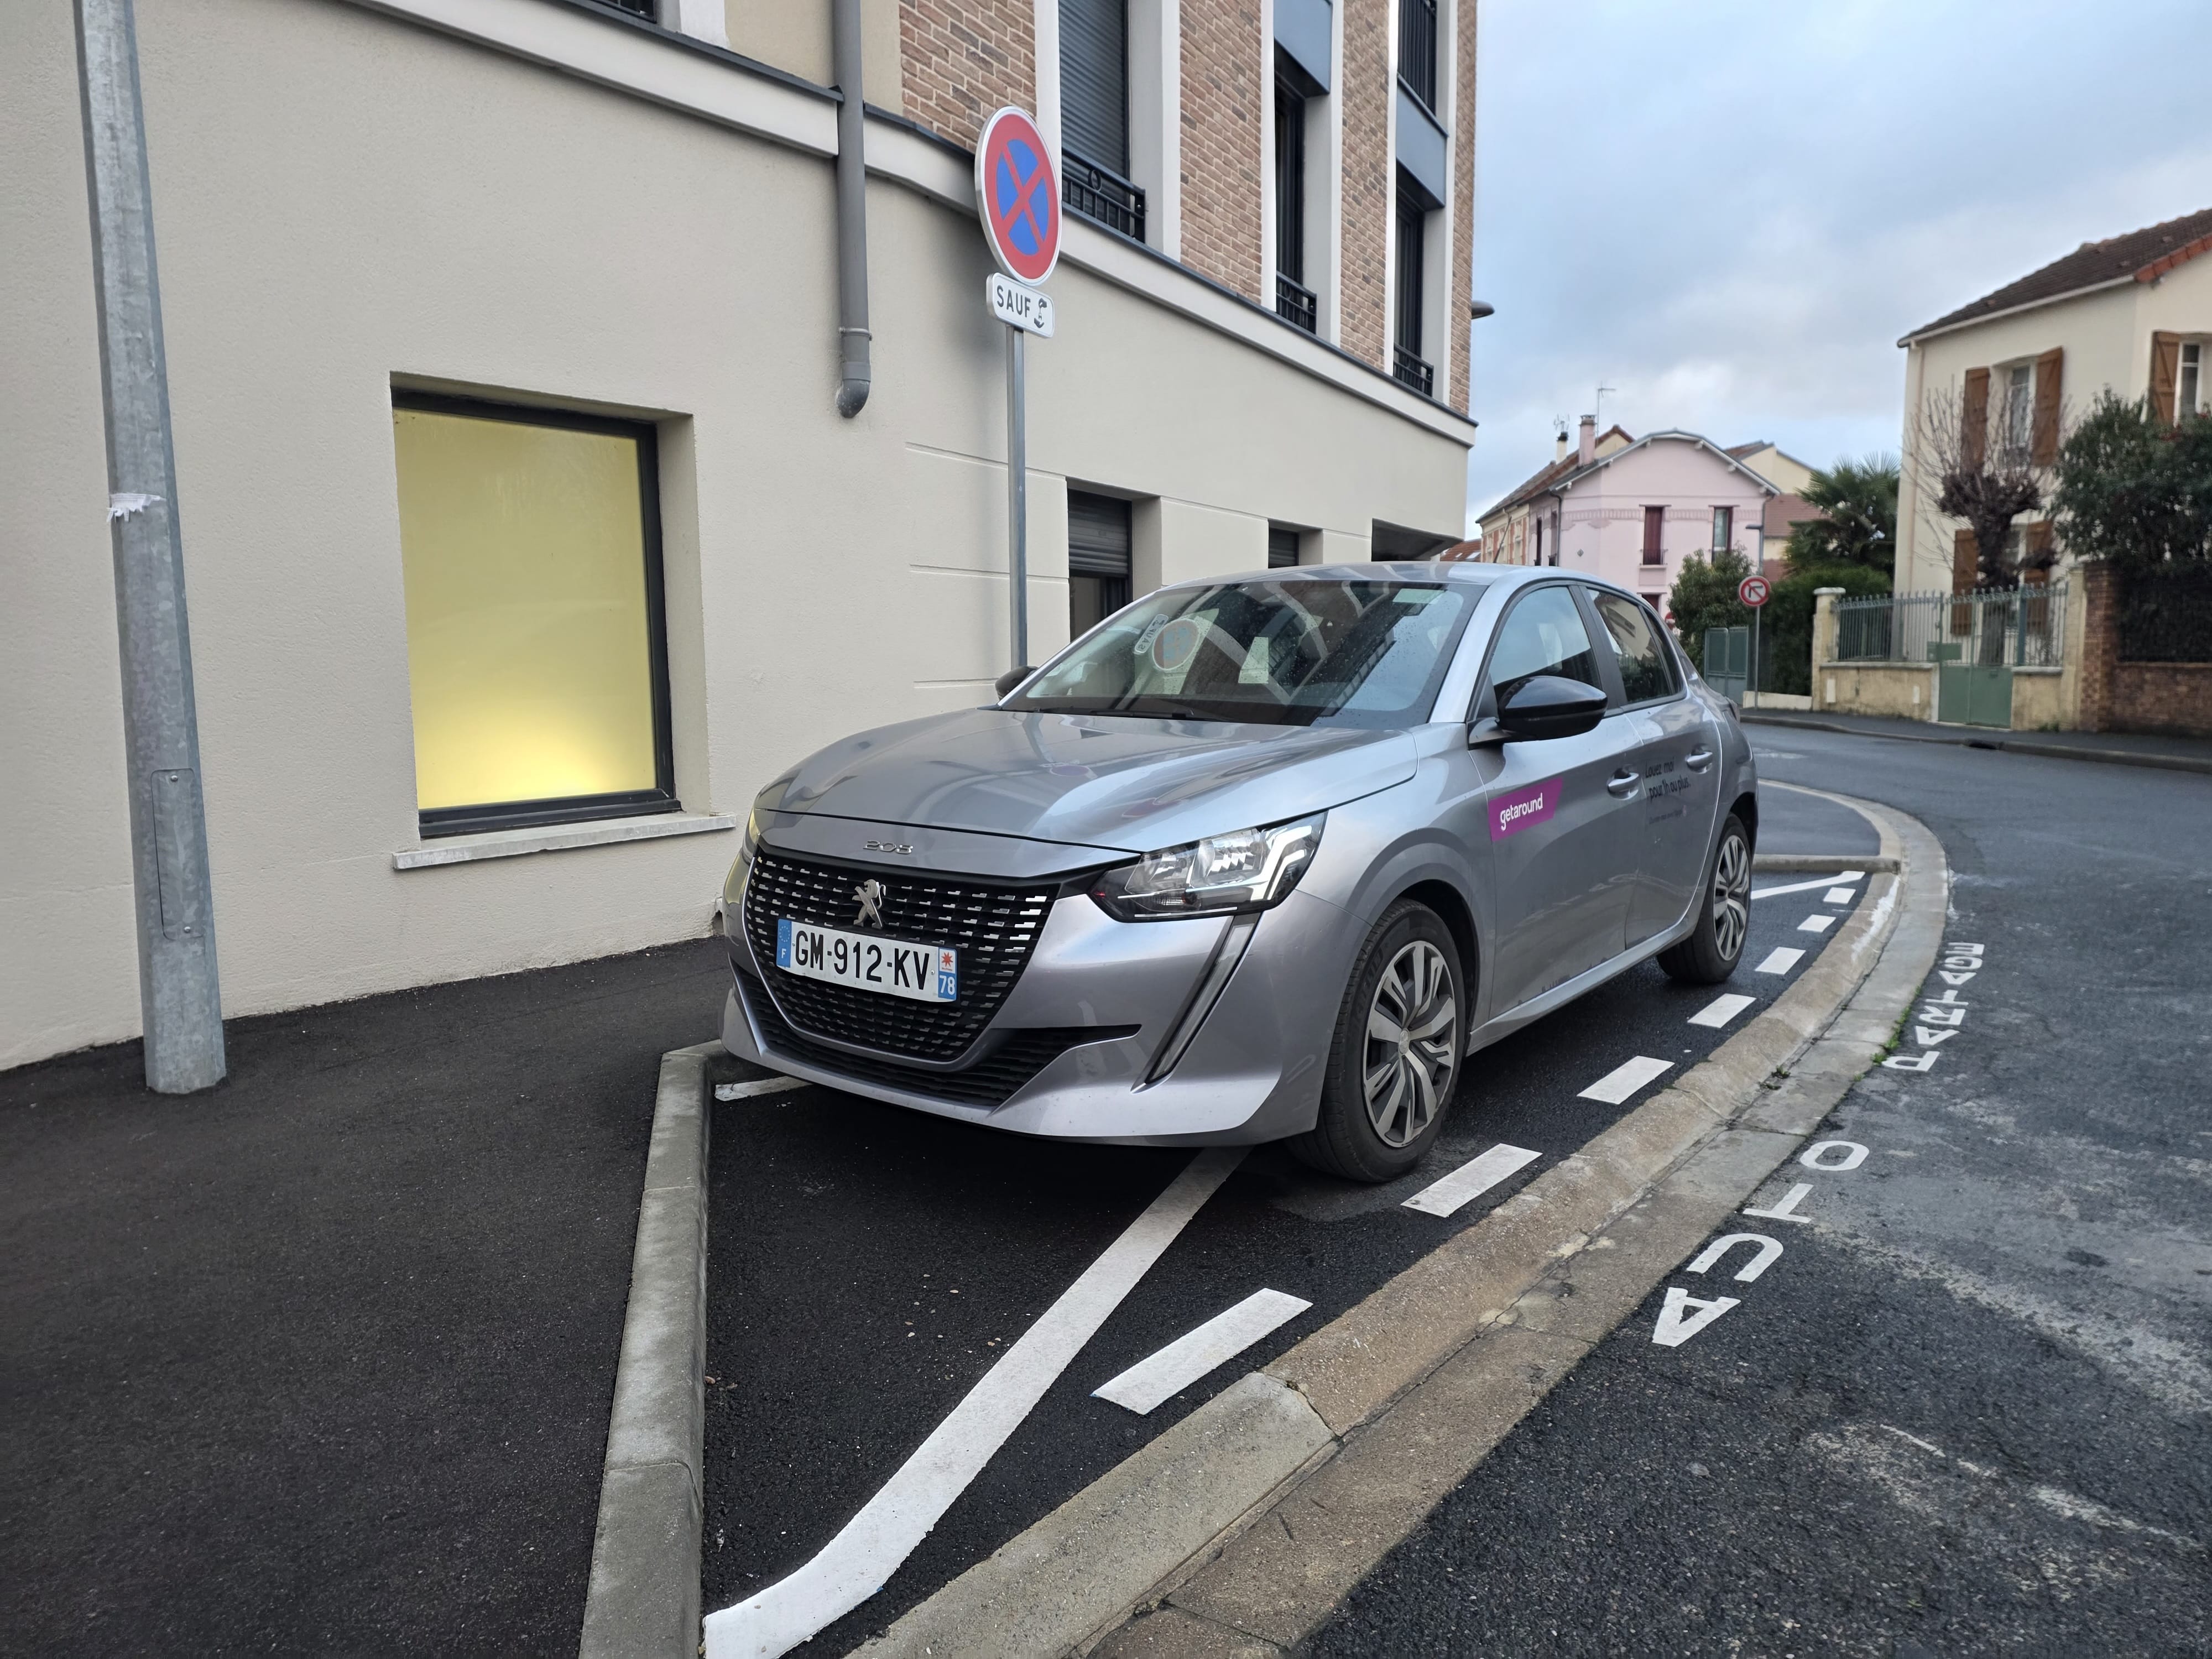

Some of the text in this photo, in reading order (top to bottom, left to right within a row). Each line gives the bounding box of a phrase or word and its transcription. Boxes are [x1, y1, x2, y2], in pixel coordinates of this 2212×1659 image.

[997, 285, 1031, 318] SAUF
[1646, 761, 1662, 778] Louez
[1649, 784, 1662, 802] pour
[1670, 780, 1677, 791] ou
[1500, 792, 1543, 831] getaround
[863, 840, 914, 855] 208
[781, 948, 786, 959] F
[795, 930, 930, 990] GM-912-KV
[939, 975, 956, 995] 78
[1651, 942, 1985, 1348] AUTO PARTAGE
